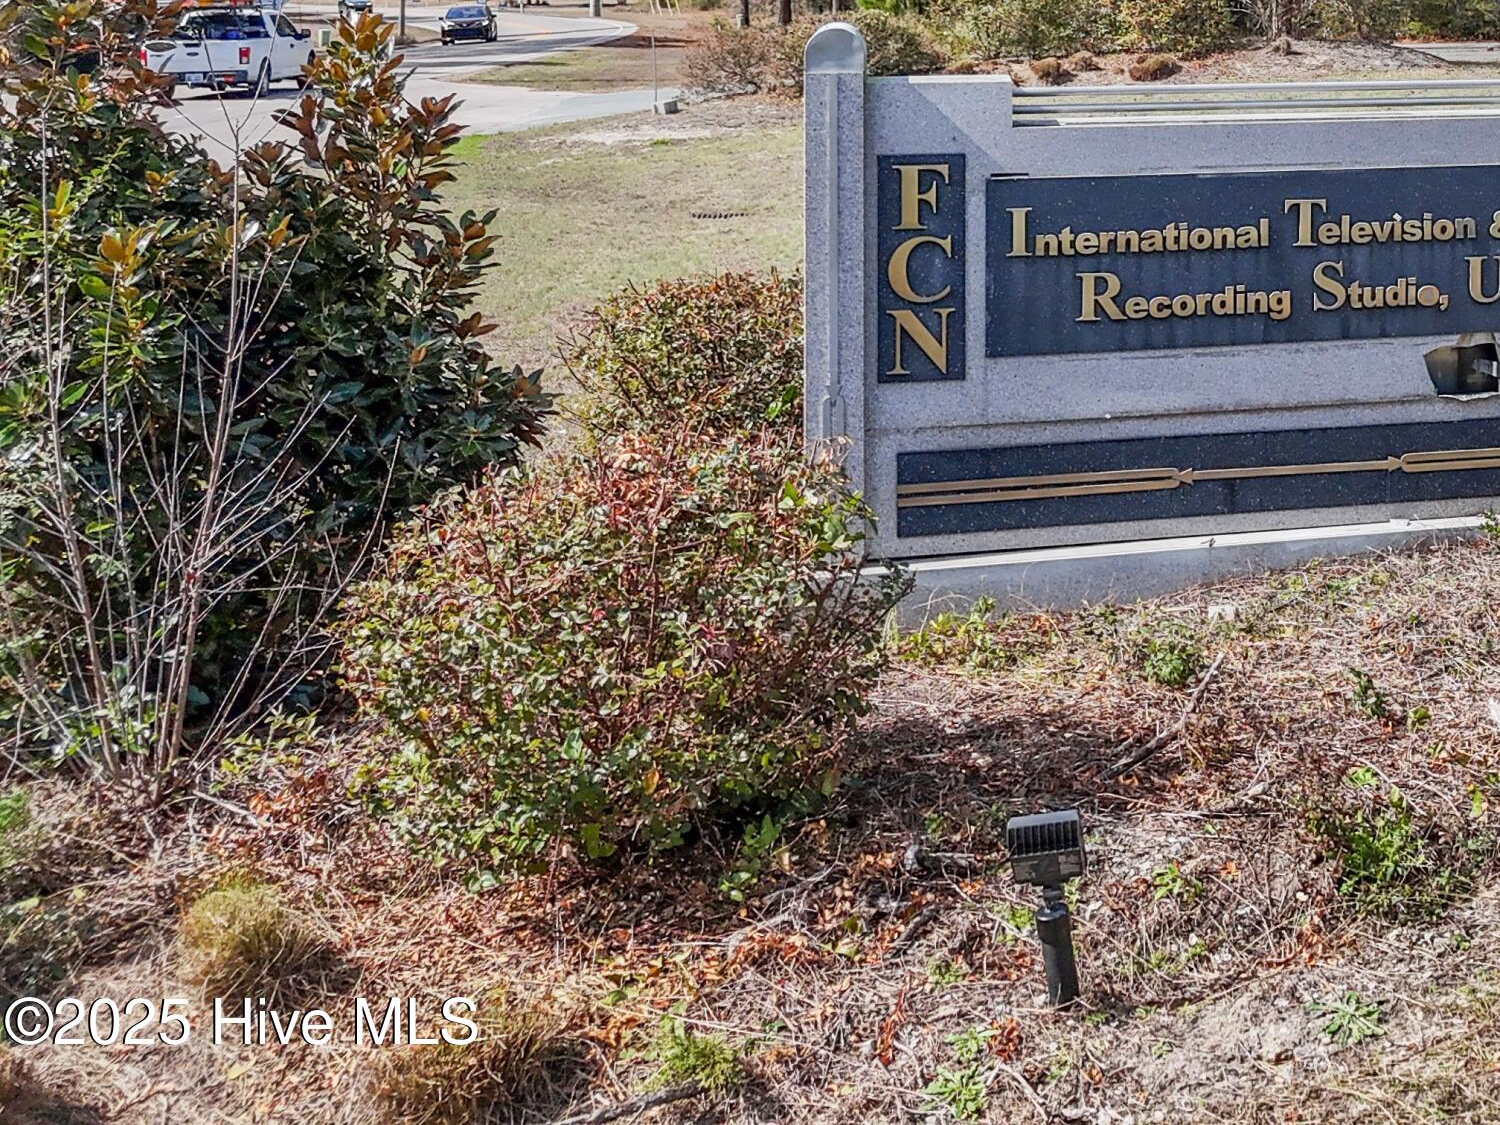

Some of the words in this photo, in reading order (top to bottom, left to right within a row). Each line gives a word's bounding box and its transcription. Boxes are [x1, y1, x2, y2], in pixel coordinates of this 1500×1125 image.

[1005, 206, 1270, 257] International
[1284, 198, 1477, 248] Television
[886, 163, 956, 375] FCN
[1075, 272, 1292, 322] Recording
[1313, 260, 1449, 312] Studio,
